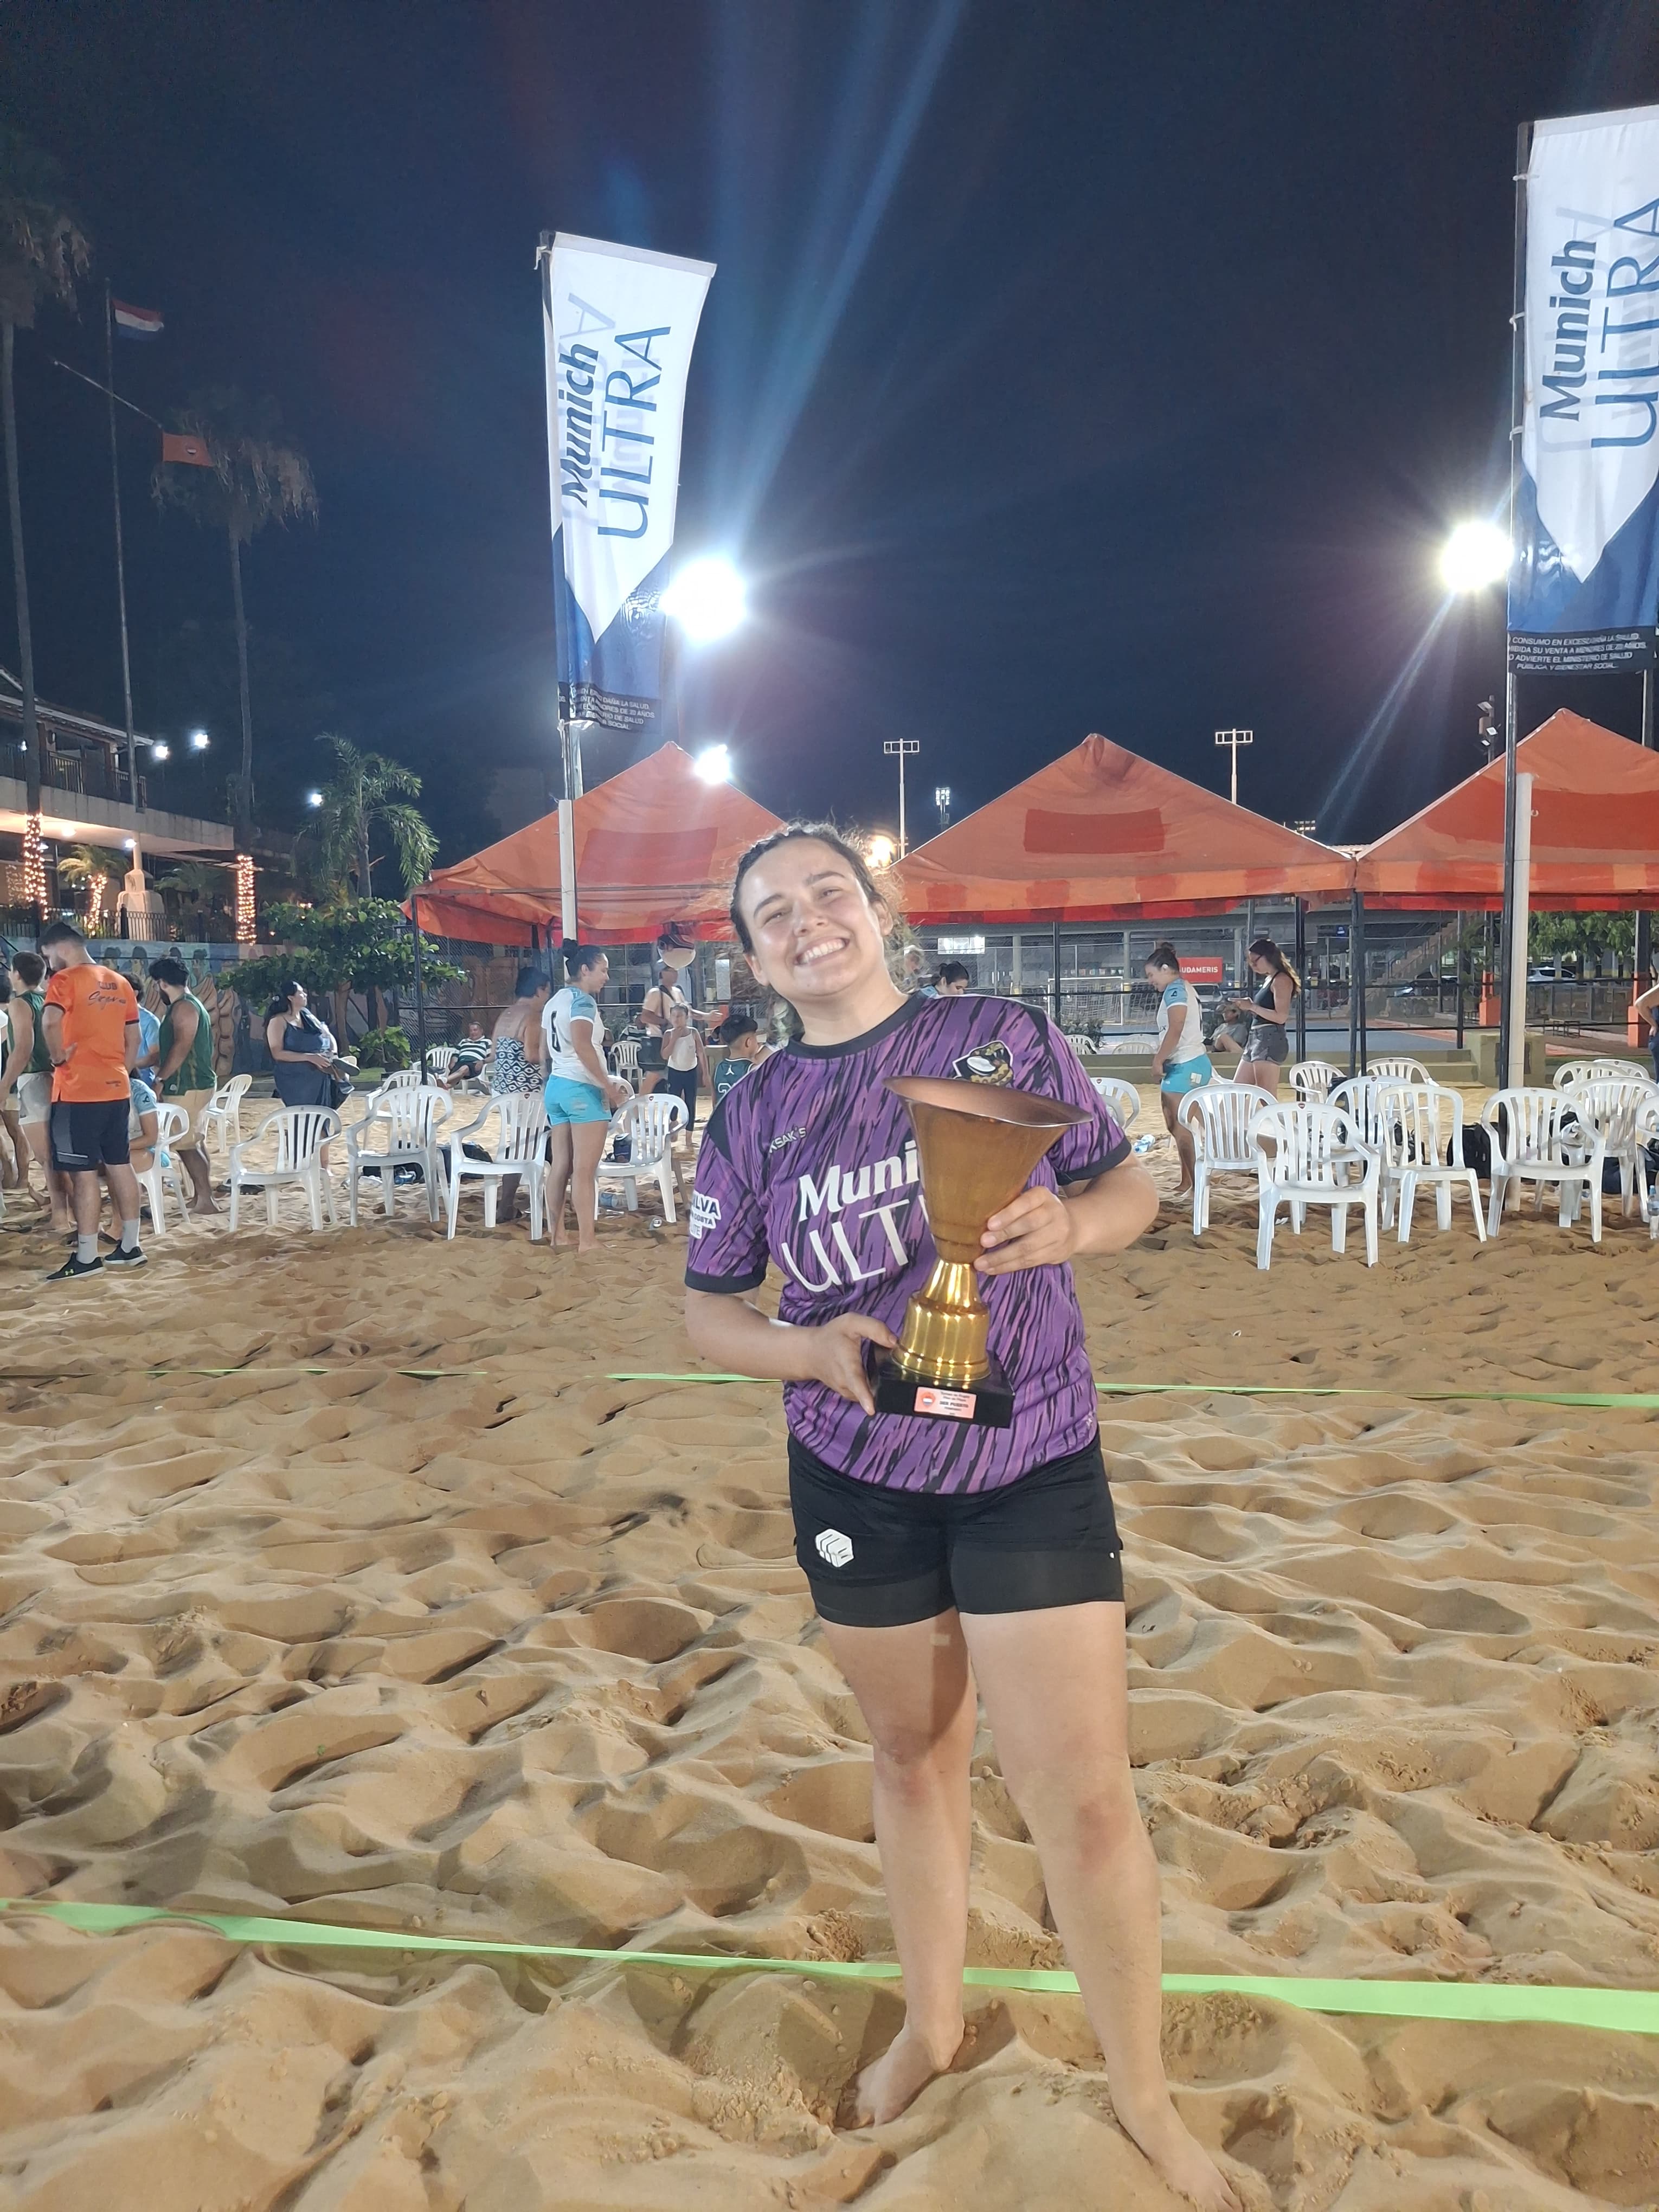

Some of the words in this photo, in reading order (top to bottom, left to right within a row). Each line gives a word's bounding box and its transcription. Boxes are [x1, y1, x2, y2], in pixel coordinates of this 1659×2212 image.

[1539, 240, 1597, 422] Munich
[558, 344, 599, 509] Munich
[597, 326, 671, 539] ULTRA
[1512, 636, 1551, 645] CONSUMO
[1515, 654, 1552, 663] ADVIERTE
[799, 1140, 919, 1221] Muni
[781, 1194, 929, 1293] ULT
